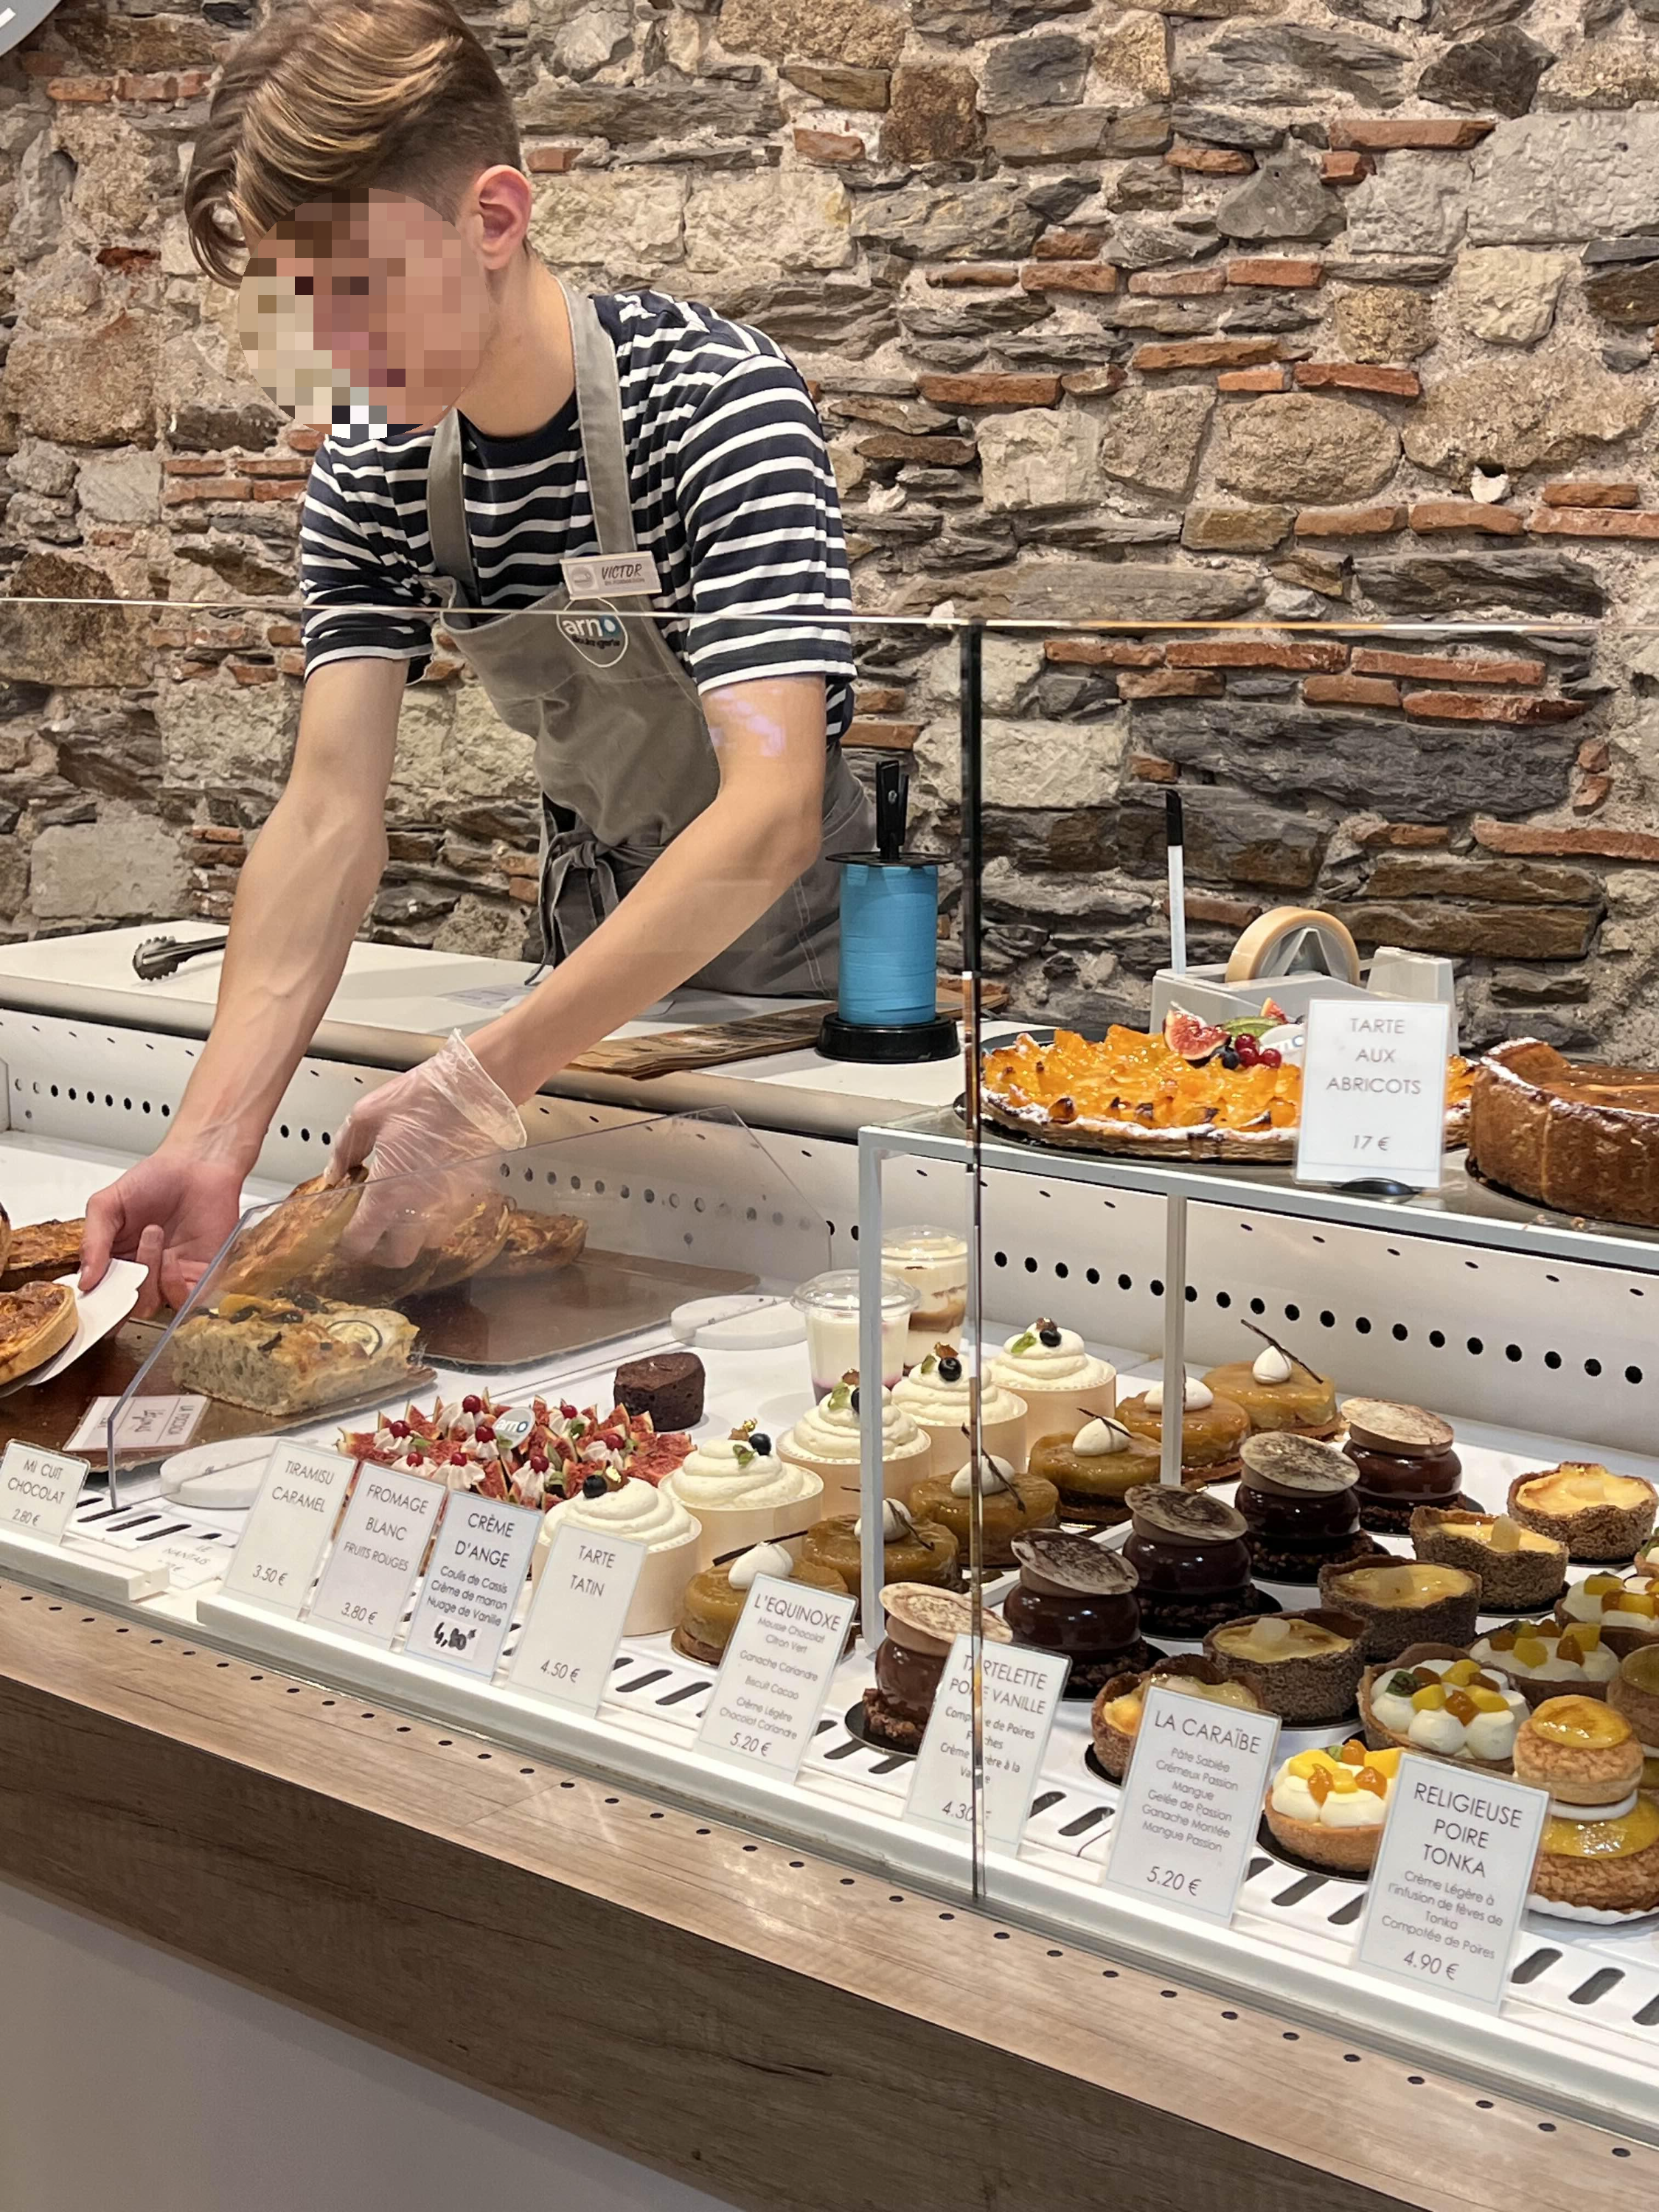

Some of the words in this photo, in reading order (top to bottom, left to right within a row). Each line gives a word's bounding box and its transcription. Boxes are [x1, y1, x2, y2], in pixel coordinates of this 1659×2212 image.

[602, 564, 642, 580] VICTOR
[1350, 1018, 1405, 1034] TARTE
[1355, 1048, 1397, 1063] AUX
[1326, 1077, 1422, 1095] ABRICOTS
[1353, 1135, 1372, 1150] 17
[1377, 1136, 1391, 1151] €
[23, 1460, 38, 1473] MI
[41, 1464, 63, 1481] CUIT
[285, 1460, 335, 1485] TIRAMISU
[7, 1477, 65, 1504] CHOCOLAT
[271, 1486, 325, 1512] CARAMEL
[367, 1484, 429, 1514] FROMAGE
[365, 1517, 407, 1541] BLANC
[467, 1512, 515, 1538] CRÈME
[343, 1541, 370, 1559] FRUITS
[371, 1551, 409, 1572] ROUGES
[454, 1540, 509, 1569] D'ANGE
[578, 1545, 616, 1569] TARTE
[252, 1565, 278, 1583] 3.50
[278, 1572, 288, 1586] €
[440, 1565, 466, 1582] Coulis
[467, 1573, 479, 1586] de
[481, 1577, 507, 1594] Cassis
[570, 1574, 605, 1597] TATIN
[431, 1579, 461, 1596] Crème
[462, 1590, 474, 1602] de
[475, 1595, 507, 1610] marron
[341, 1601, 367, 1621] 3.80
[368, 1611, 378, 1625] €
[427, 1596, 456, 1614] Nuage
[458, 1604, 470, 1618] de
[473, 1608, 502, 1627] Vanille
[754, 1593, 842, 1631] L'EQUINOXE
[758, 1617, 787, 1633] Mousse
[788, 1624, 826, 1644] Chocolat
[765, 1634, 790, 1649] Citron
[791, 1641, 808, 1654] Vert
[540, 1659, 569, 1680] 4.50
[569, 1668, 581, 1683] €
[740, 1649, 777, 1670] Ganache
[779, 1661, 818, 1682] Coriandre
[963, 1655, 1048, 1690] TRTELETTE
[745, 1675, 770, 1691] Biscuit
[771, 1683, 799, 1700] Cacao
[737, 1697, 764, 1714] Crème
[765, 1705, 793, 1722] Légère
[993, 1689, 1046, 1715] VANILLE
[720, 1707, 757, 1726] Chocolat
[758, 1719, 798, 1740] Coriandre
[993, 1719, 1005, 1731] de
[1006, 1722, 1035, 1740] Poires
[1154, 1711, 1176, 1731] LA
[1182, 1719, 1262, 1755] CARAÏBE
[730, 1732, 759, 1753] 5.20
[761, 1742, 772, 1757] €
[940, 1742, 970, 1759] Crème
[1012, 1761, 1020, 1773] la
[1197, 1754, 1230, 1773] Sablée
[1172, 1781, 1214, 1801] Mangue
[1203, 1772, 1239, 1792] Passion
[1148, 1790, 1178, 1806] Gelée
[1180, 1798, 1194, 1812] de
[1196, 1804, 1232, 1822] Passion
[1413, 1782, 1523, 1829] RELIGIEUSE
[1142, 1804, 1189, 1826] Ganache
[1192, 1817, 1231, 1839] Montée
[1433, 1818, 1489, 1848] POIRE
[1142, 1820, 1184, 1842] Mangue
[1186, 1832, 1222, 1853] Passion
[1424, 1843, 1486, 1878] TONKA
[1147, 1865, 1184, 1891] 5.20
[1189, 1878, 1202, 1896] €
[1405, 1871, 1442, 1891] Crème
[1444, 1881, 1484, 1903] Légère
[1486, 1893, 1495, 1906] à
[1388, 1883, 1436, 1905] l'infusion
[1438, 1899, 1453, 1911] de
[1455, 1904, 1485, 1922] fèves
[1487, 1913, 1503, 1927] de
[1426, 1910, 1458, 1930] Tonka
[1382, 1915, 1442, 1943] Compotée
[1444, 1935, 1461, 1948] de
[1462, 1940, 1495, 1960] Poires
[1404, 1951, 1442, 1975] 4.90
[1446, 1963, 1460, 1981] €
